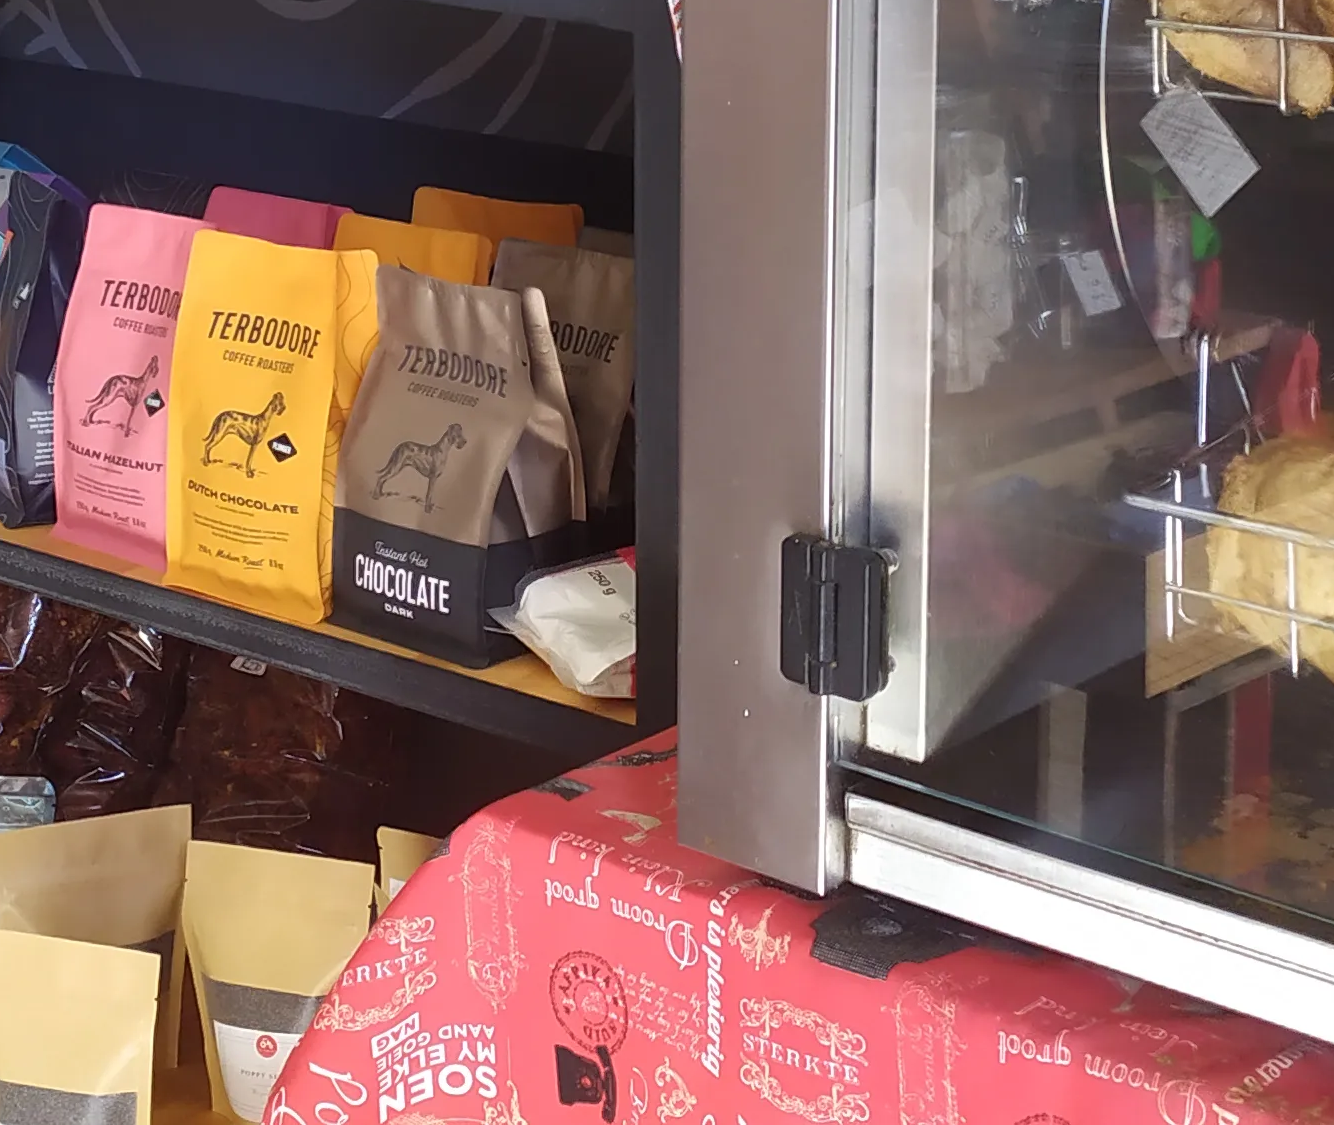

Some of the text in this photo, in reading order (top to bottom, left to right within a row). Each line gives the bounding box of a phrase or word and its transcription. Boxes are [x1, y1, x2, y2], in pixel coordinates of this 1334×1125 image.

[113, 315, 145, 333] COFFEE
[207, 310, 322, 360] TERBODORE
[222, 349, 295, 375] COFFEE ROASTERS
[397, 343, 509, 400] TERBODORE
[407, 380, 480, 408] COFFEE ROASTERS
[104, 453, 163, 473] HAZELNUT
[188, 479, 299, 515] DUTCH CHOCOLATE
[374, 540, 429, 569] Instant Hot
[355, 553, 451, 614] CHOCOLATE
[587, 569, 612, 589] 250
[384, 602, 414, 619] DARK
[548, 831, 615, 877] kind
[544, 877, 699, 970] Droom groot
[702, 921, 726, 1078] is plesierig
[376, 1014, 419, 1051] NAG
[376, 1024, 495, 1073] AAND GOEIE
[997, 1030, 1073, 1066] groot
[377, 1043, 446, 1093] ELKE
[458, 1042, 496, 1064] MY
[742, 1033, 860, 1086] STERKTE
[379, 1064, 497, 1124] SOEN
